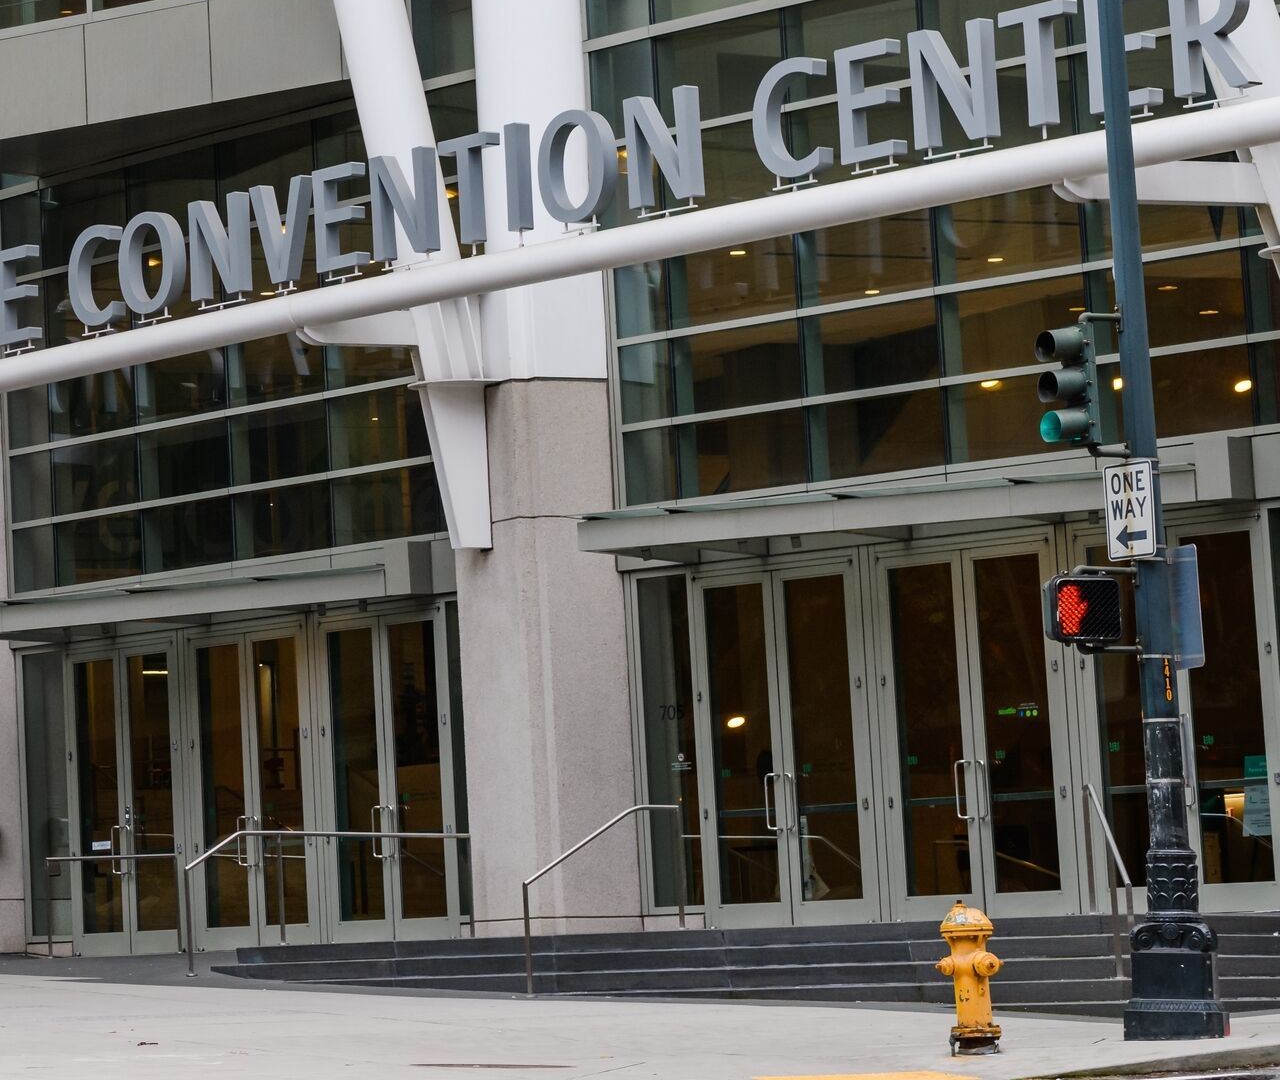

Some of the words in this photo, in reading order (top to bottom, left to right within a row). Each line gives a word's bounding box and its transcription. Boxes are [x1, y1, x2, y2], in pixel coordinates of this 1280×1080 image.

[69, 84, 706, 330] CONVENTION
[1110, 469, 1145, 495] ONE
[1111, 495, 1147, 521] WAY
